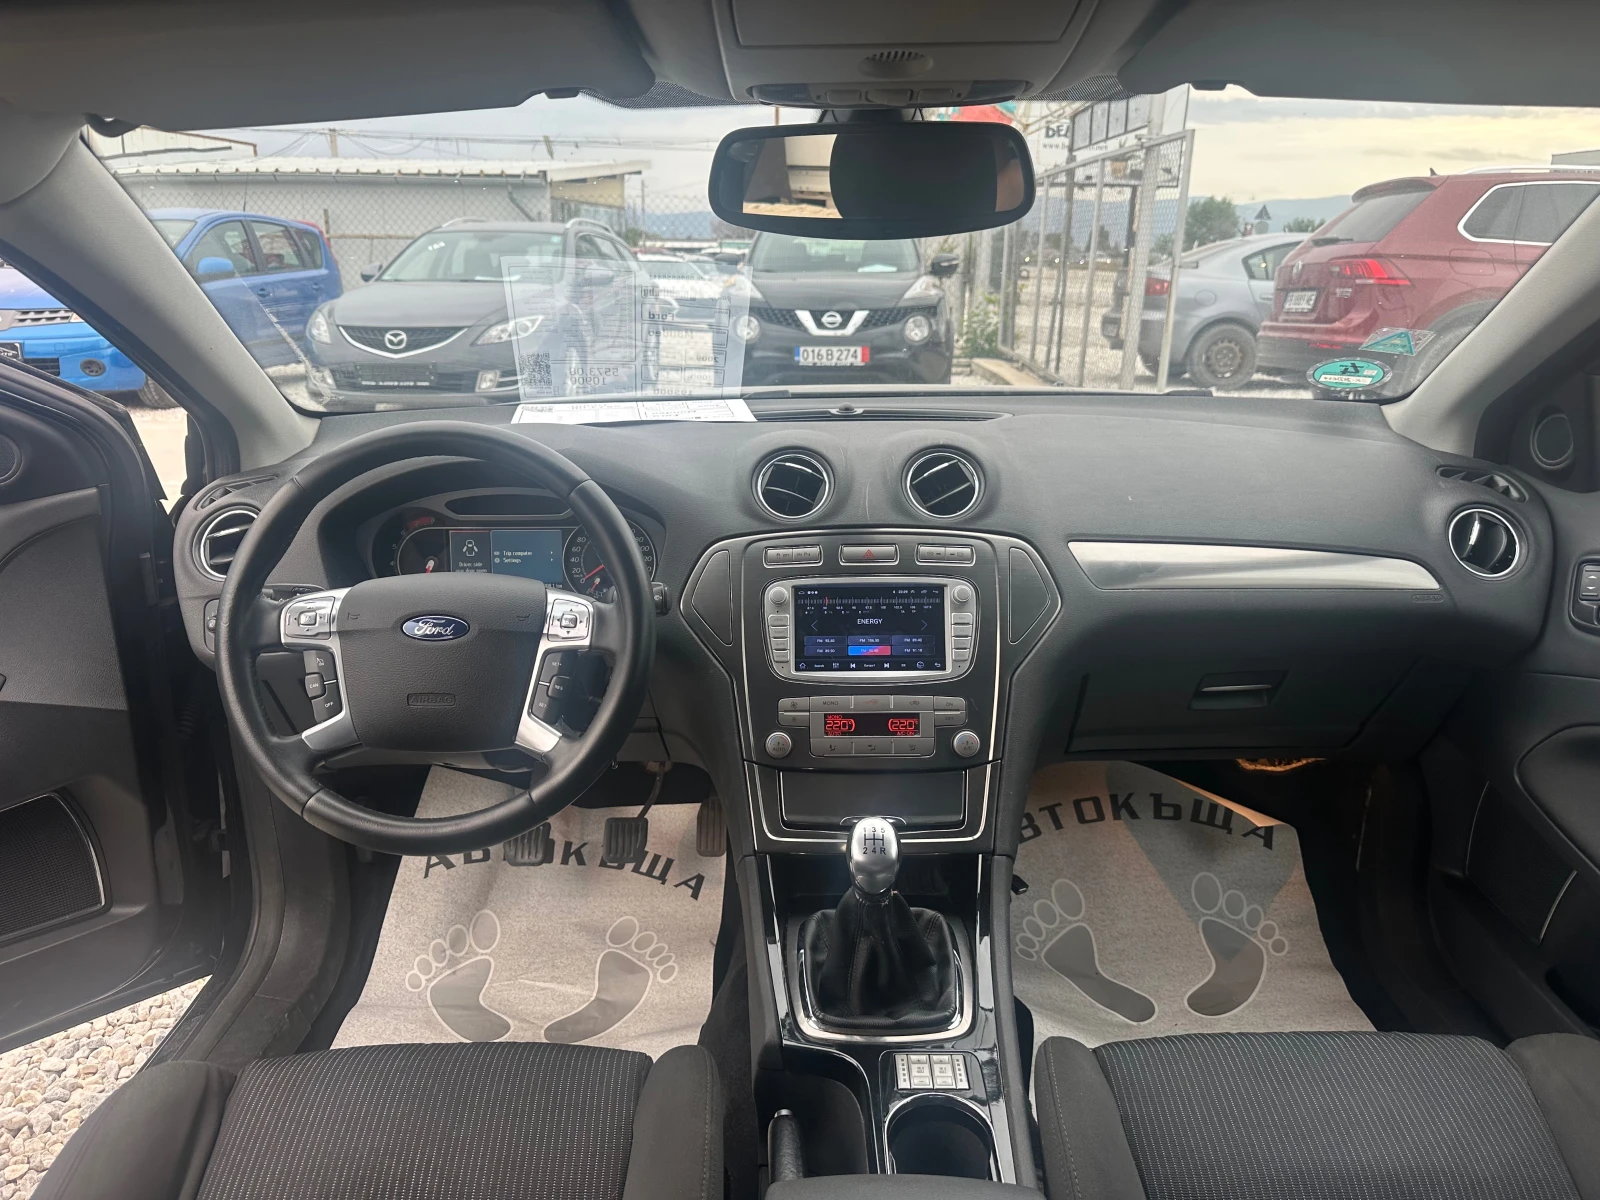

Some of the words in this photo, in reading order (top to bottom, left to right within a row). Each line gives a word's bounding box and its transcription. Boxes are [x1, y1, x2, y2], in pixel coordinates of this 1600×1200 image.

[415, 619, 456, 635] Ford
[411, 696, 453, 704] AIRBAG
[1019, 792, 1274, 850] ВТОКЪЩА
[863, 847, 868, 855] 2
[880, 847, 887, 855] R
